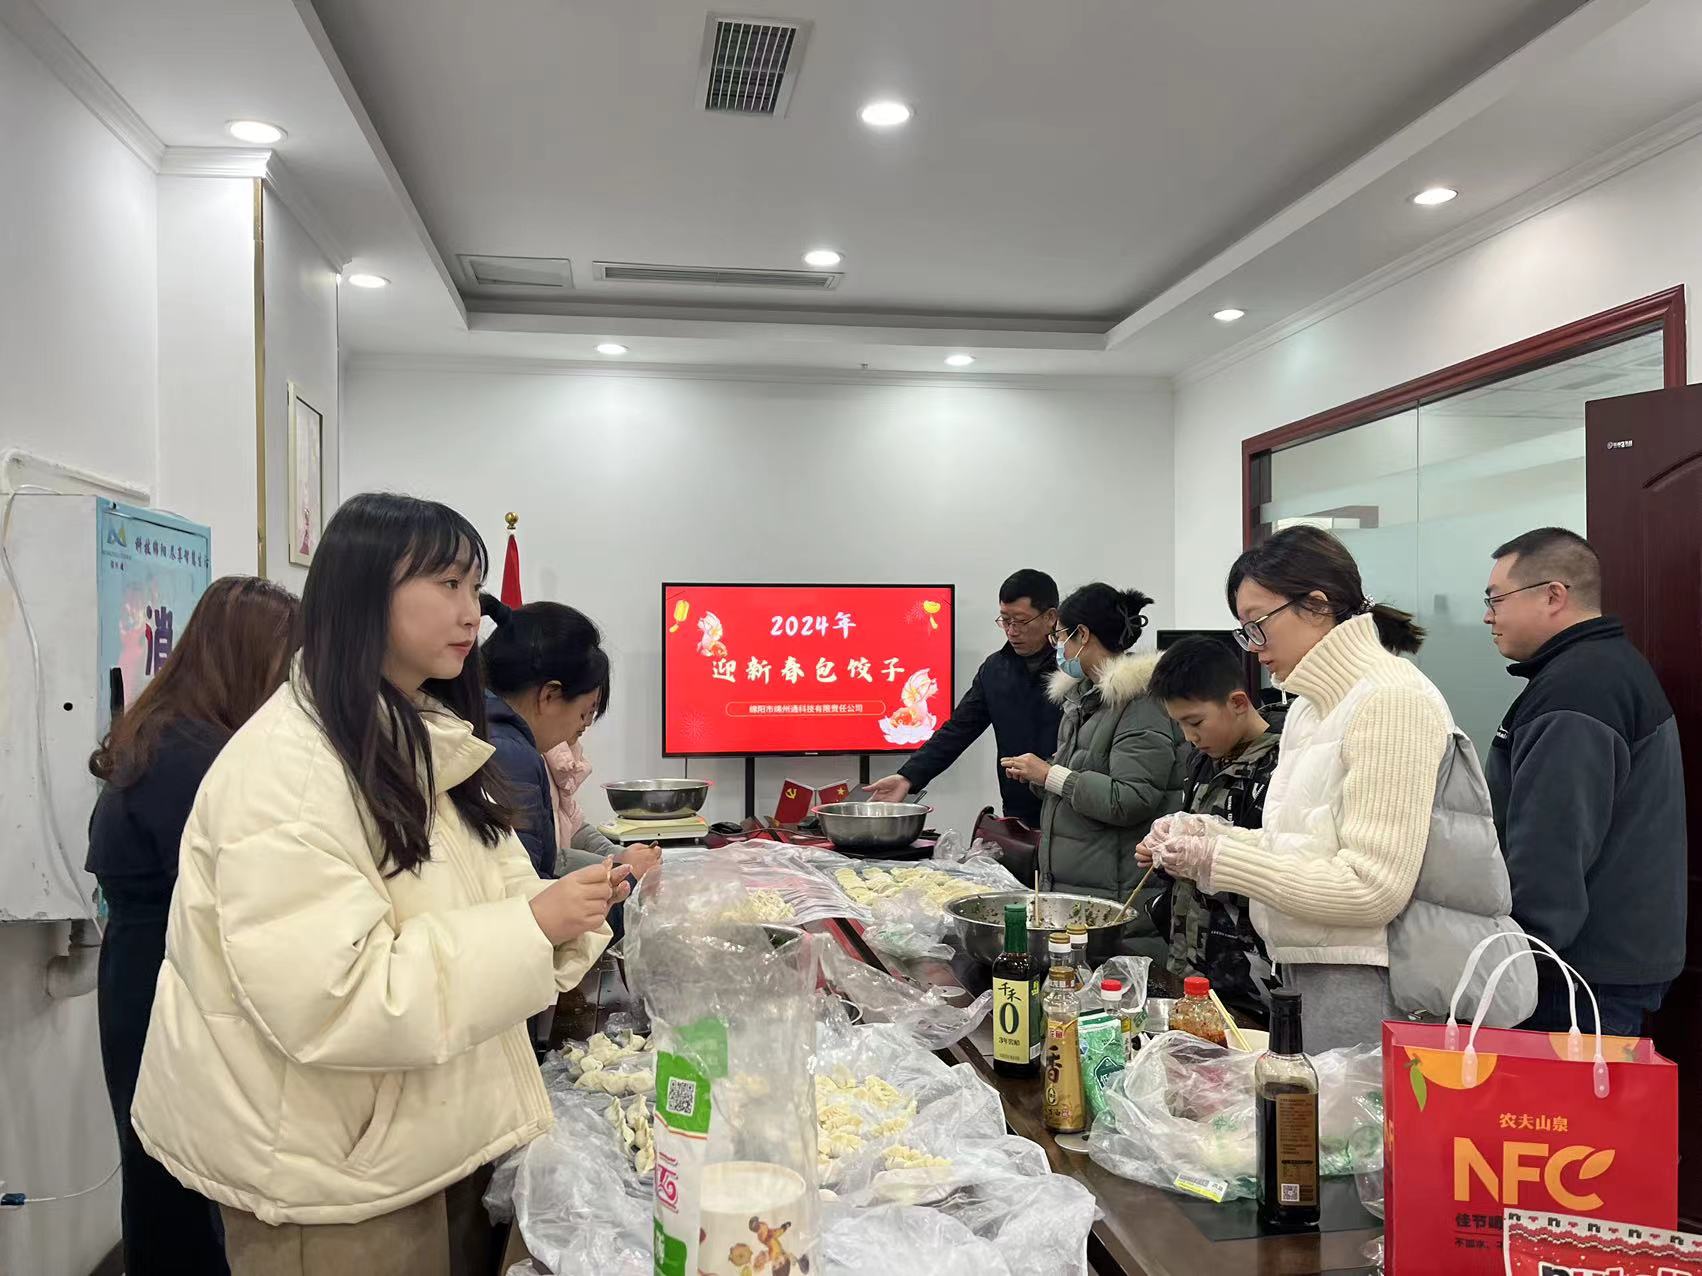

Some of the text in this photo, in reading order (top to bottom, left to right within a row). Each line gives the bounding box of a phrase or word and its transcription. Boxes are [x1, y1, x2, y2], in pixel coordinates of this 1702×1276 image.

[770, 611, 857, 639] 2024年
[712, 656, 905, 685] 迎新春包饺子
[998, 982, 1022, 1003] 千禾
[1498, 1112, 1569, 1133] 农夫山泉
[1454, 1136, 1615, 1212] NFC
